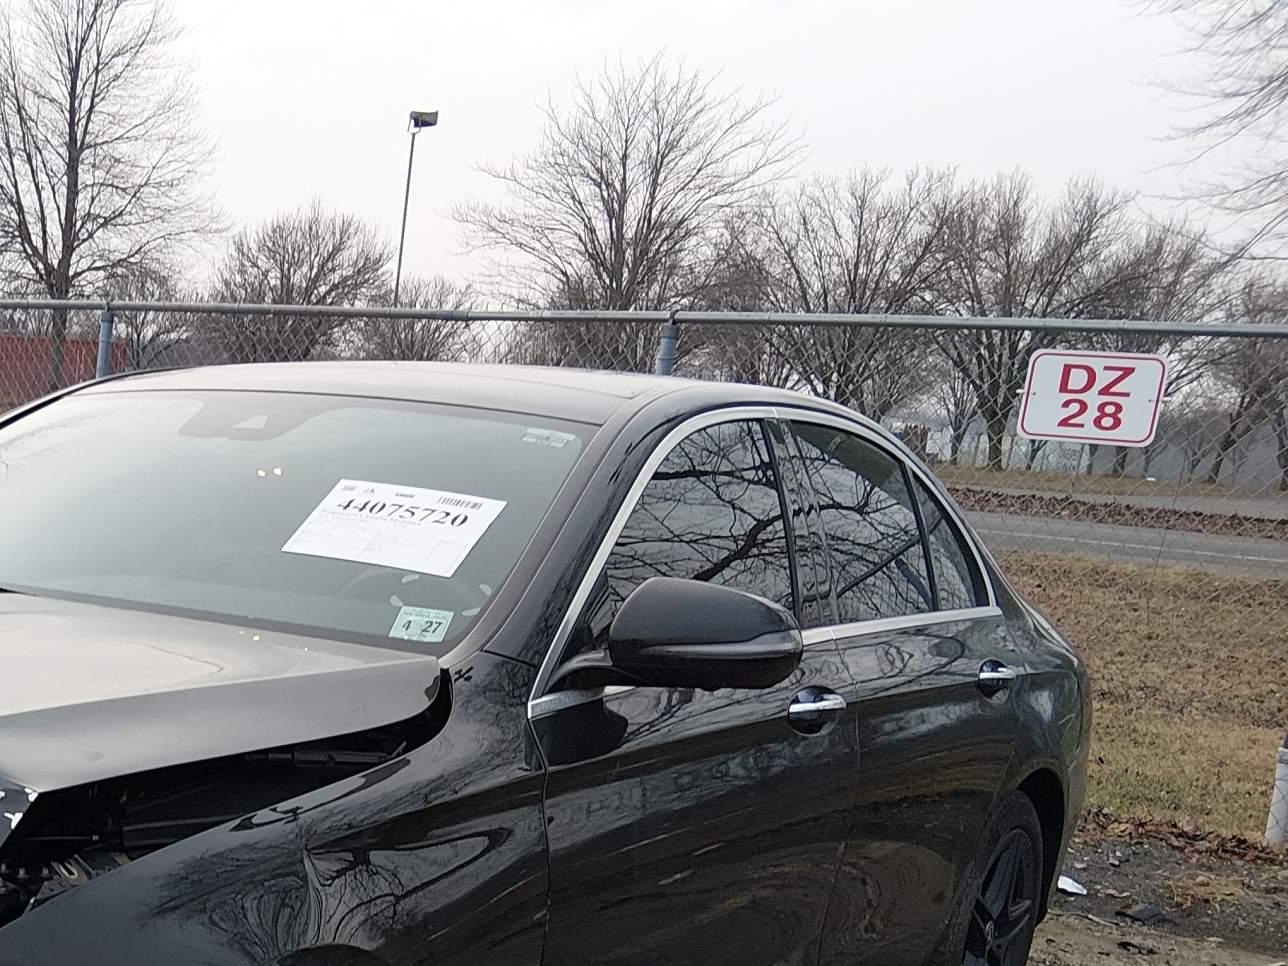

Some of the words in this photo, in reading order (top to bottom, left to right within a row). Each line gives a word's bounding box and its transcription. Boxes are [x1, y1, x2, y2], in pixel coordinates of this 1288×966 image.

[1058, 363, 1136, 398] DZ
[1056, 398, 1124, 431] 28
[336, 498, 469, 528] 44075720
[421, 620, 443, 634] 27
